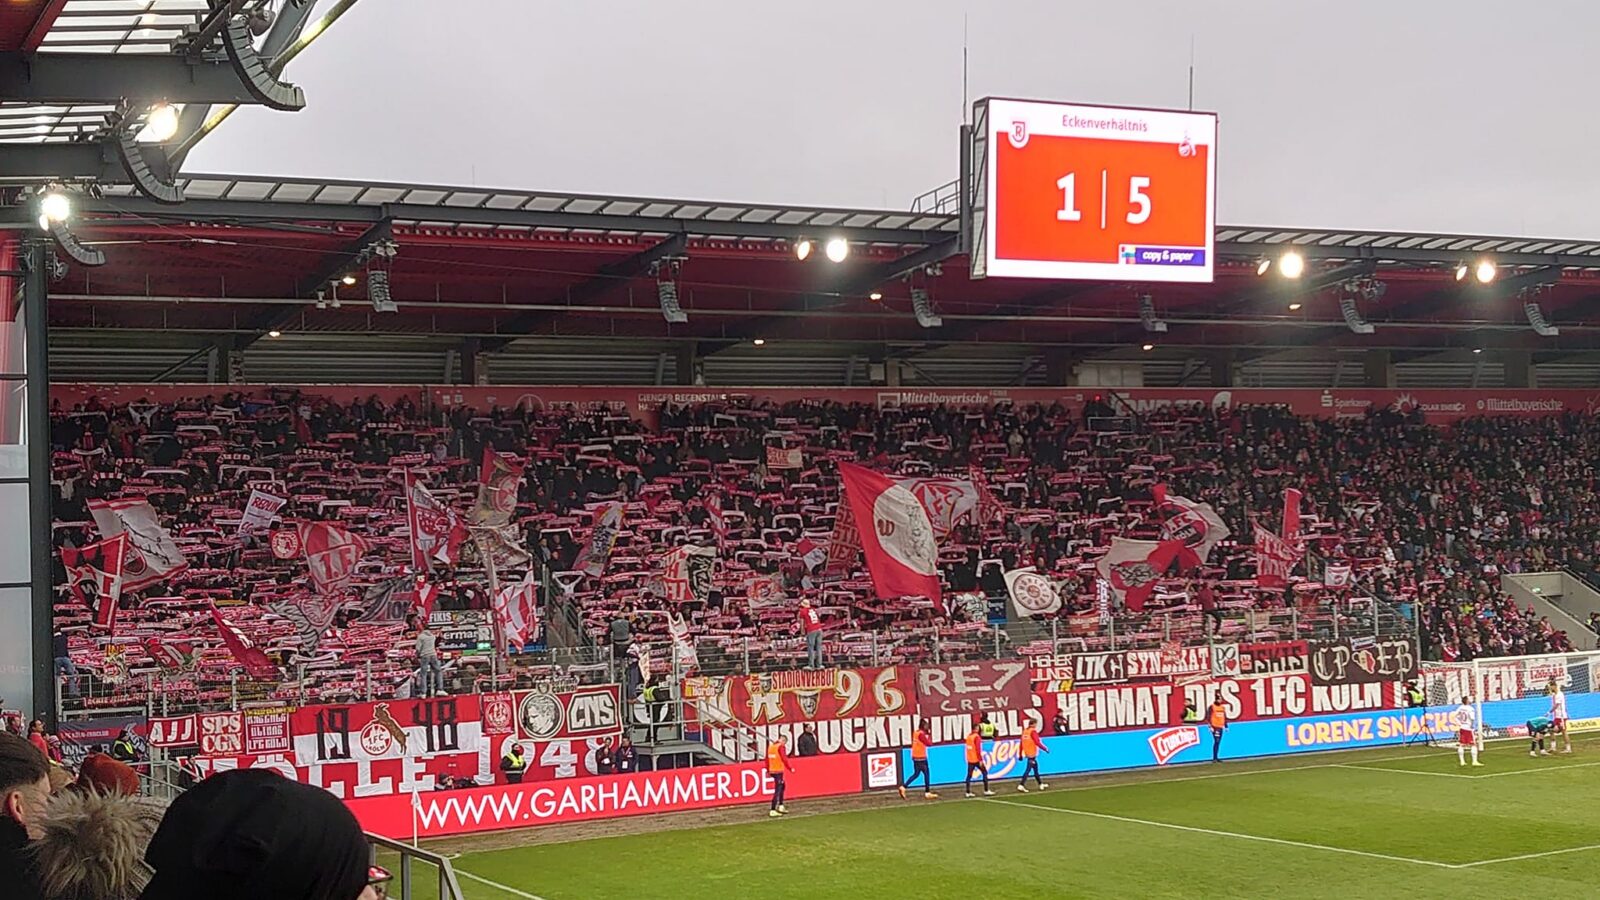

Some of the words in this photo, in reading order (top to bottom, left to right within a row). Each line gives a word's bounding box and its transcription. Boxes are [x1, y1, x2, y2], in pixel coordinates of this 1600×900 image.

[1062, 114, 1148, 132] Eckenverhältnis
[1056, 172, 1081, 221] 1
[1126, 176, 1152, 224] 5
[1142, 251, 1162, 262] copy
[1170, 252, 1194, 262] paper
[1076, 655, 1108, 680] LTK
[1127, 648, 1210, 675] SYNKAT
[772, 668, 838, 690] STADIONVERBOT
[919, 662, 1026, 697] RE7
[940, 697, 1009, 711] CREW
[1057, 685, 1172, 731] HEIMAT
[1250, 675, 1306, 716] 1.FC
[150, 719, 193, 742] AJJ
[202, 714, 242, 735] SPS
[315, 708, 352, 760] 19
[1286, 718, 1375, 747] LORENZ
[1377, 711, 1461, 739] SNACKS
[203, 733, 242, 753] CGN
[177, 755, 436, 800] LLE
[418, 769, 774, 830] WWW.GARHAMMER.DE
